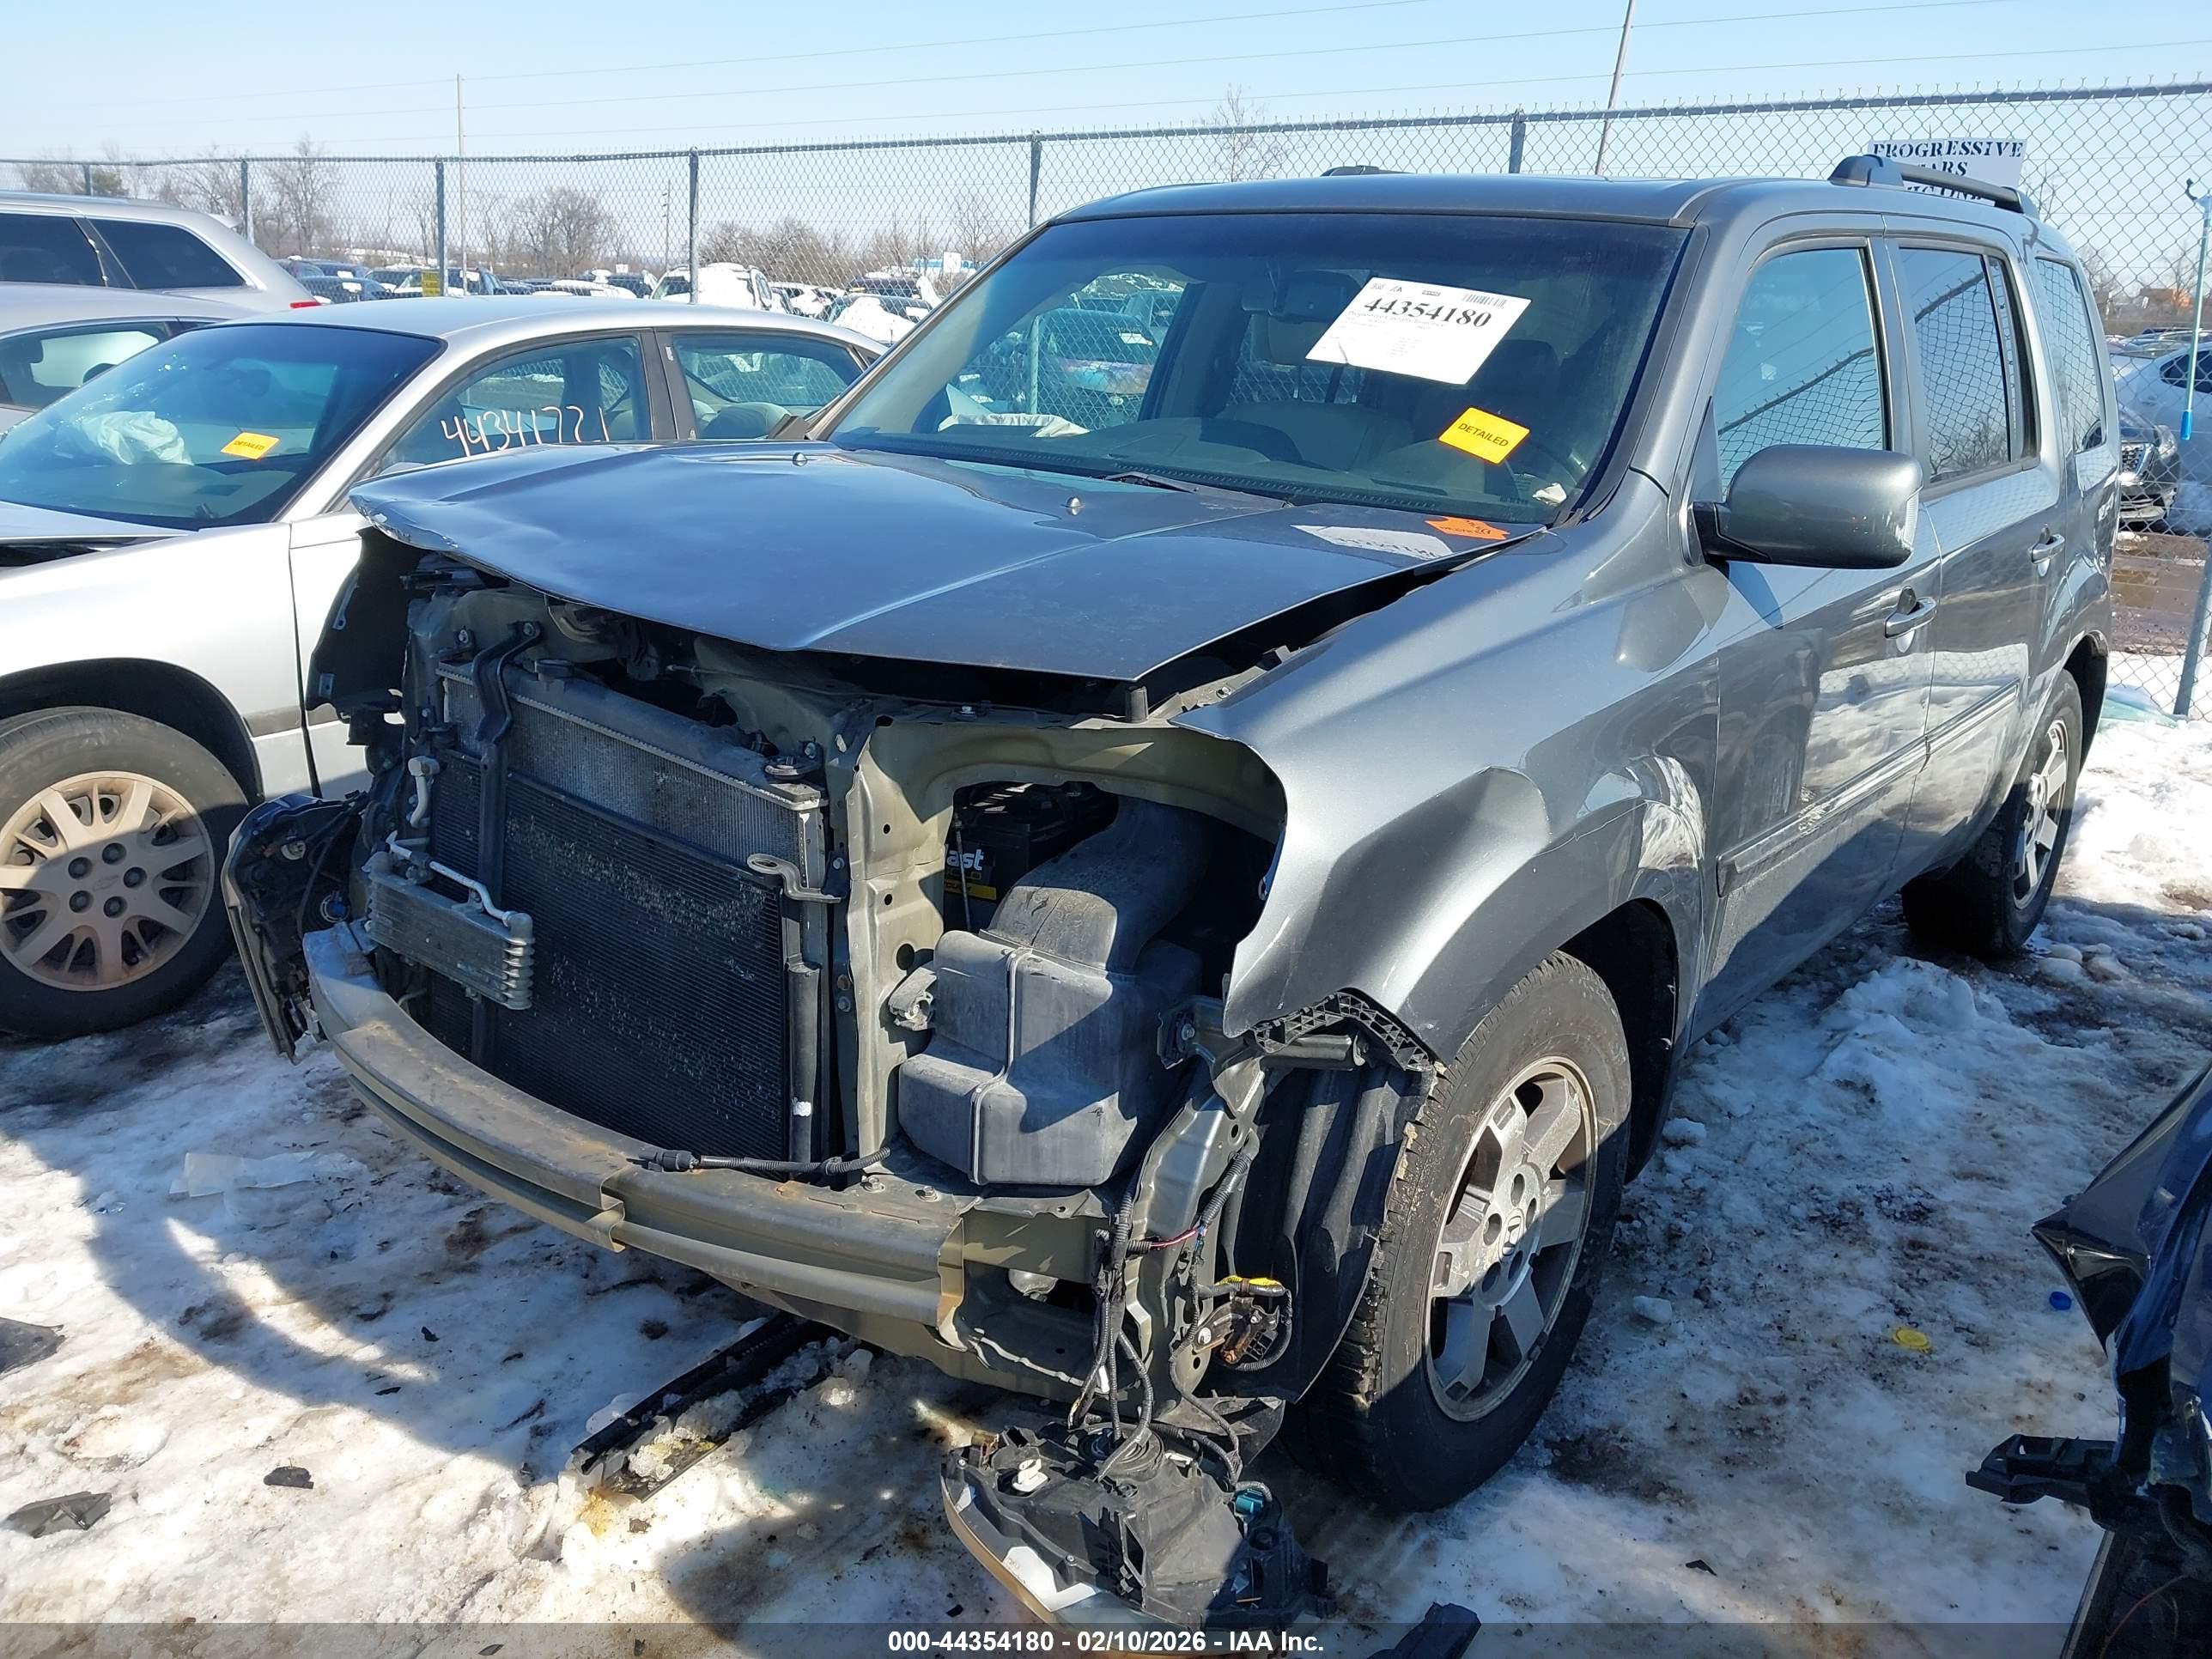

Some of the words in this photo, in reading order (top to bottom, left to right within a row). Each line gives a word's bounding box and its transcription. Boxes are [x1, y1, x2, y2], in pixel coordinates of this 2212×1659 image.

[1873, 140, 2024, 158] PROGRESSIVE
[1364, 297, 1492, 328] 44354180
[1457, 422, 1510, 447] DETAILED
